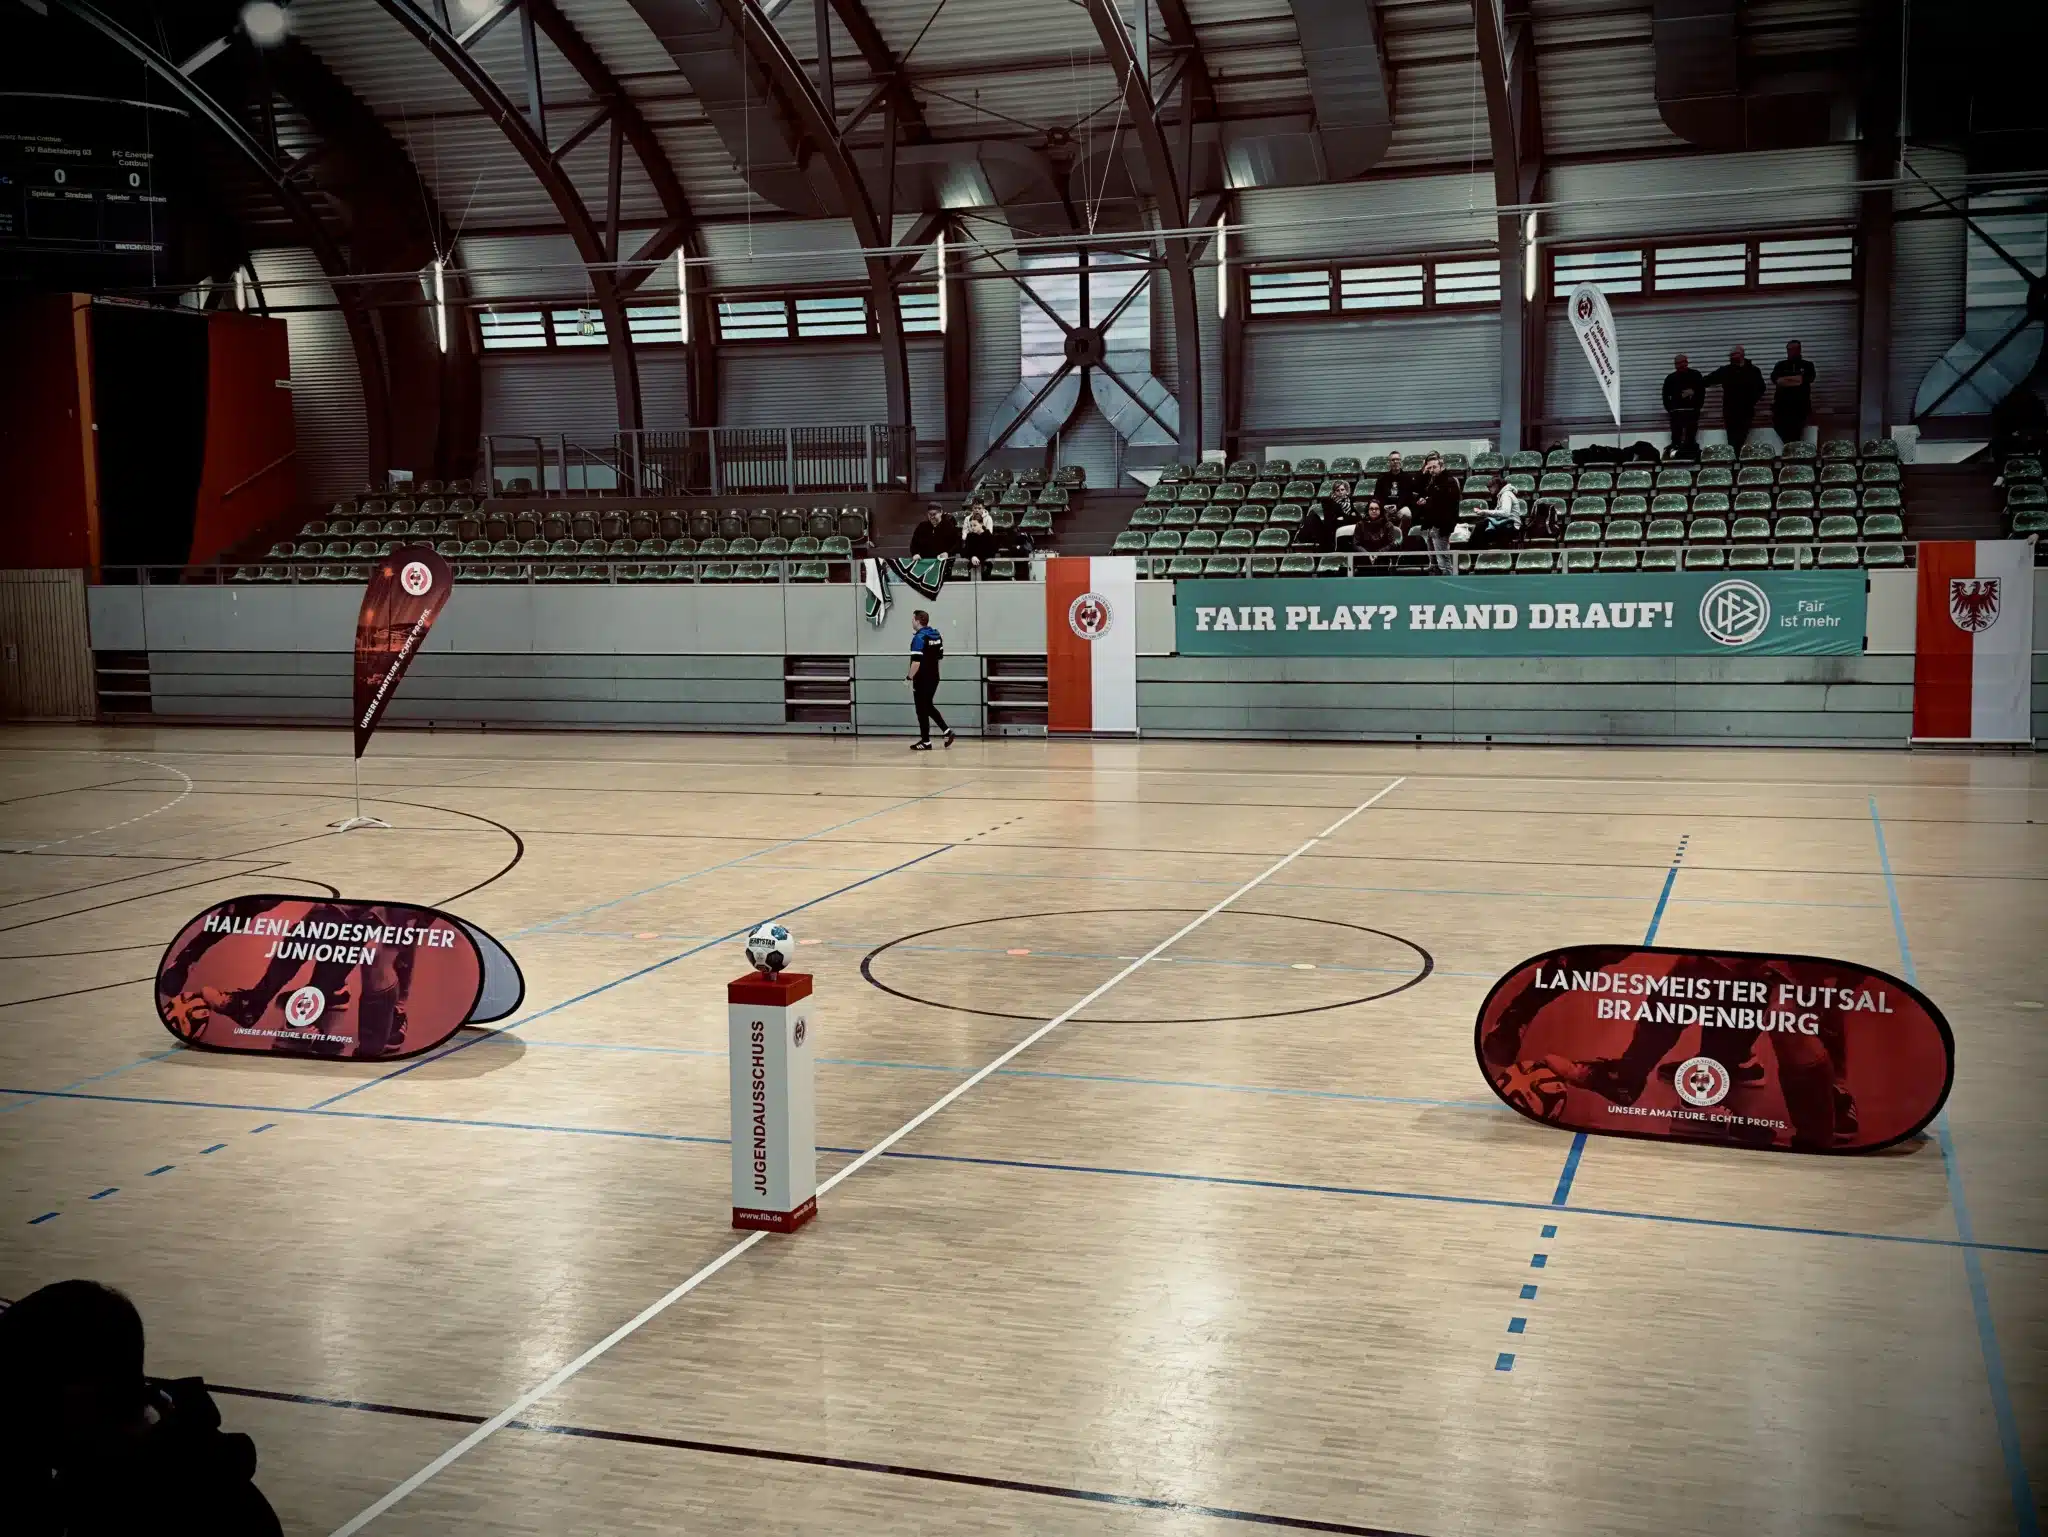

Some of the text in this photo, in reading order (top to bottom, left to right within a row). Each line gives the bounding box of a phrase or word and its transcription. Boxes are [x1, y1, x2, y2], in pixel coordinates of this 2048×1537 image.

[37, 147, 82, 157] Babelsberg
[82, 148, 92, 156] 03
[112, 150, 124, 158] FC
[118, 159, 149, 168] Cottbus
[54, 169, 66, 184] 0
[129, 172, 141, 188] 0
[31, 190, 56, 199] Spieler
[106, 193, 130, 202] Spieler
[1584, 332, 1605, 375] Brandenburg
[1589, 326, 1615, 375] Landesverband
[1196, 601, 1674, 632] FAIR PLAY? HAND DRAUF!
[1798, 600, 1825, 612] Fair
[1780, 615, 1841, 627] ist mehr
[360, 699, 379, 729] UNSERE
[398, 636, 415, 663] ECHTE
[412, 608, 432, 637] PROFIS.
[204, 914, 456, 949] HALLENLANDESMEISTER
[264, 940, 377, 966] JUNIOREN
[1534, 967, 1894, 1014] LANDESMEISTER FUTSAL
[1596, 998, 1820, 1036] BRANDENBURG
[233, 1027, 261, 1037] UNSERE
[301, 1032, 327, 1043] ECHTE
[327, 1034, 355, 1045] PROFIS.
[751, 1019, 767, 1196] JUGENDAUSSCHUSS
[1607, 1105, 1789, 1130] UNSERE AMATEURE. ECHTE PROFIS.
